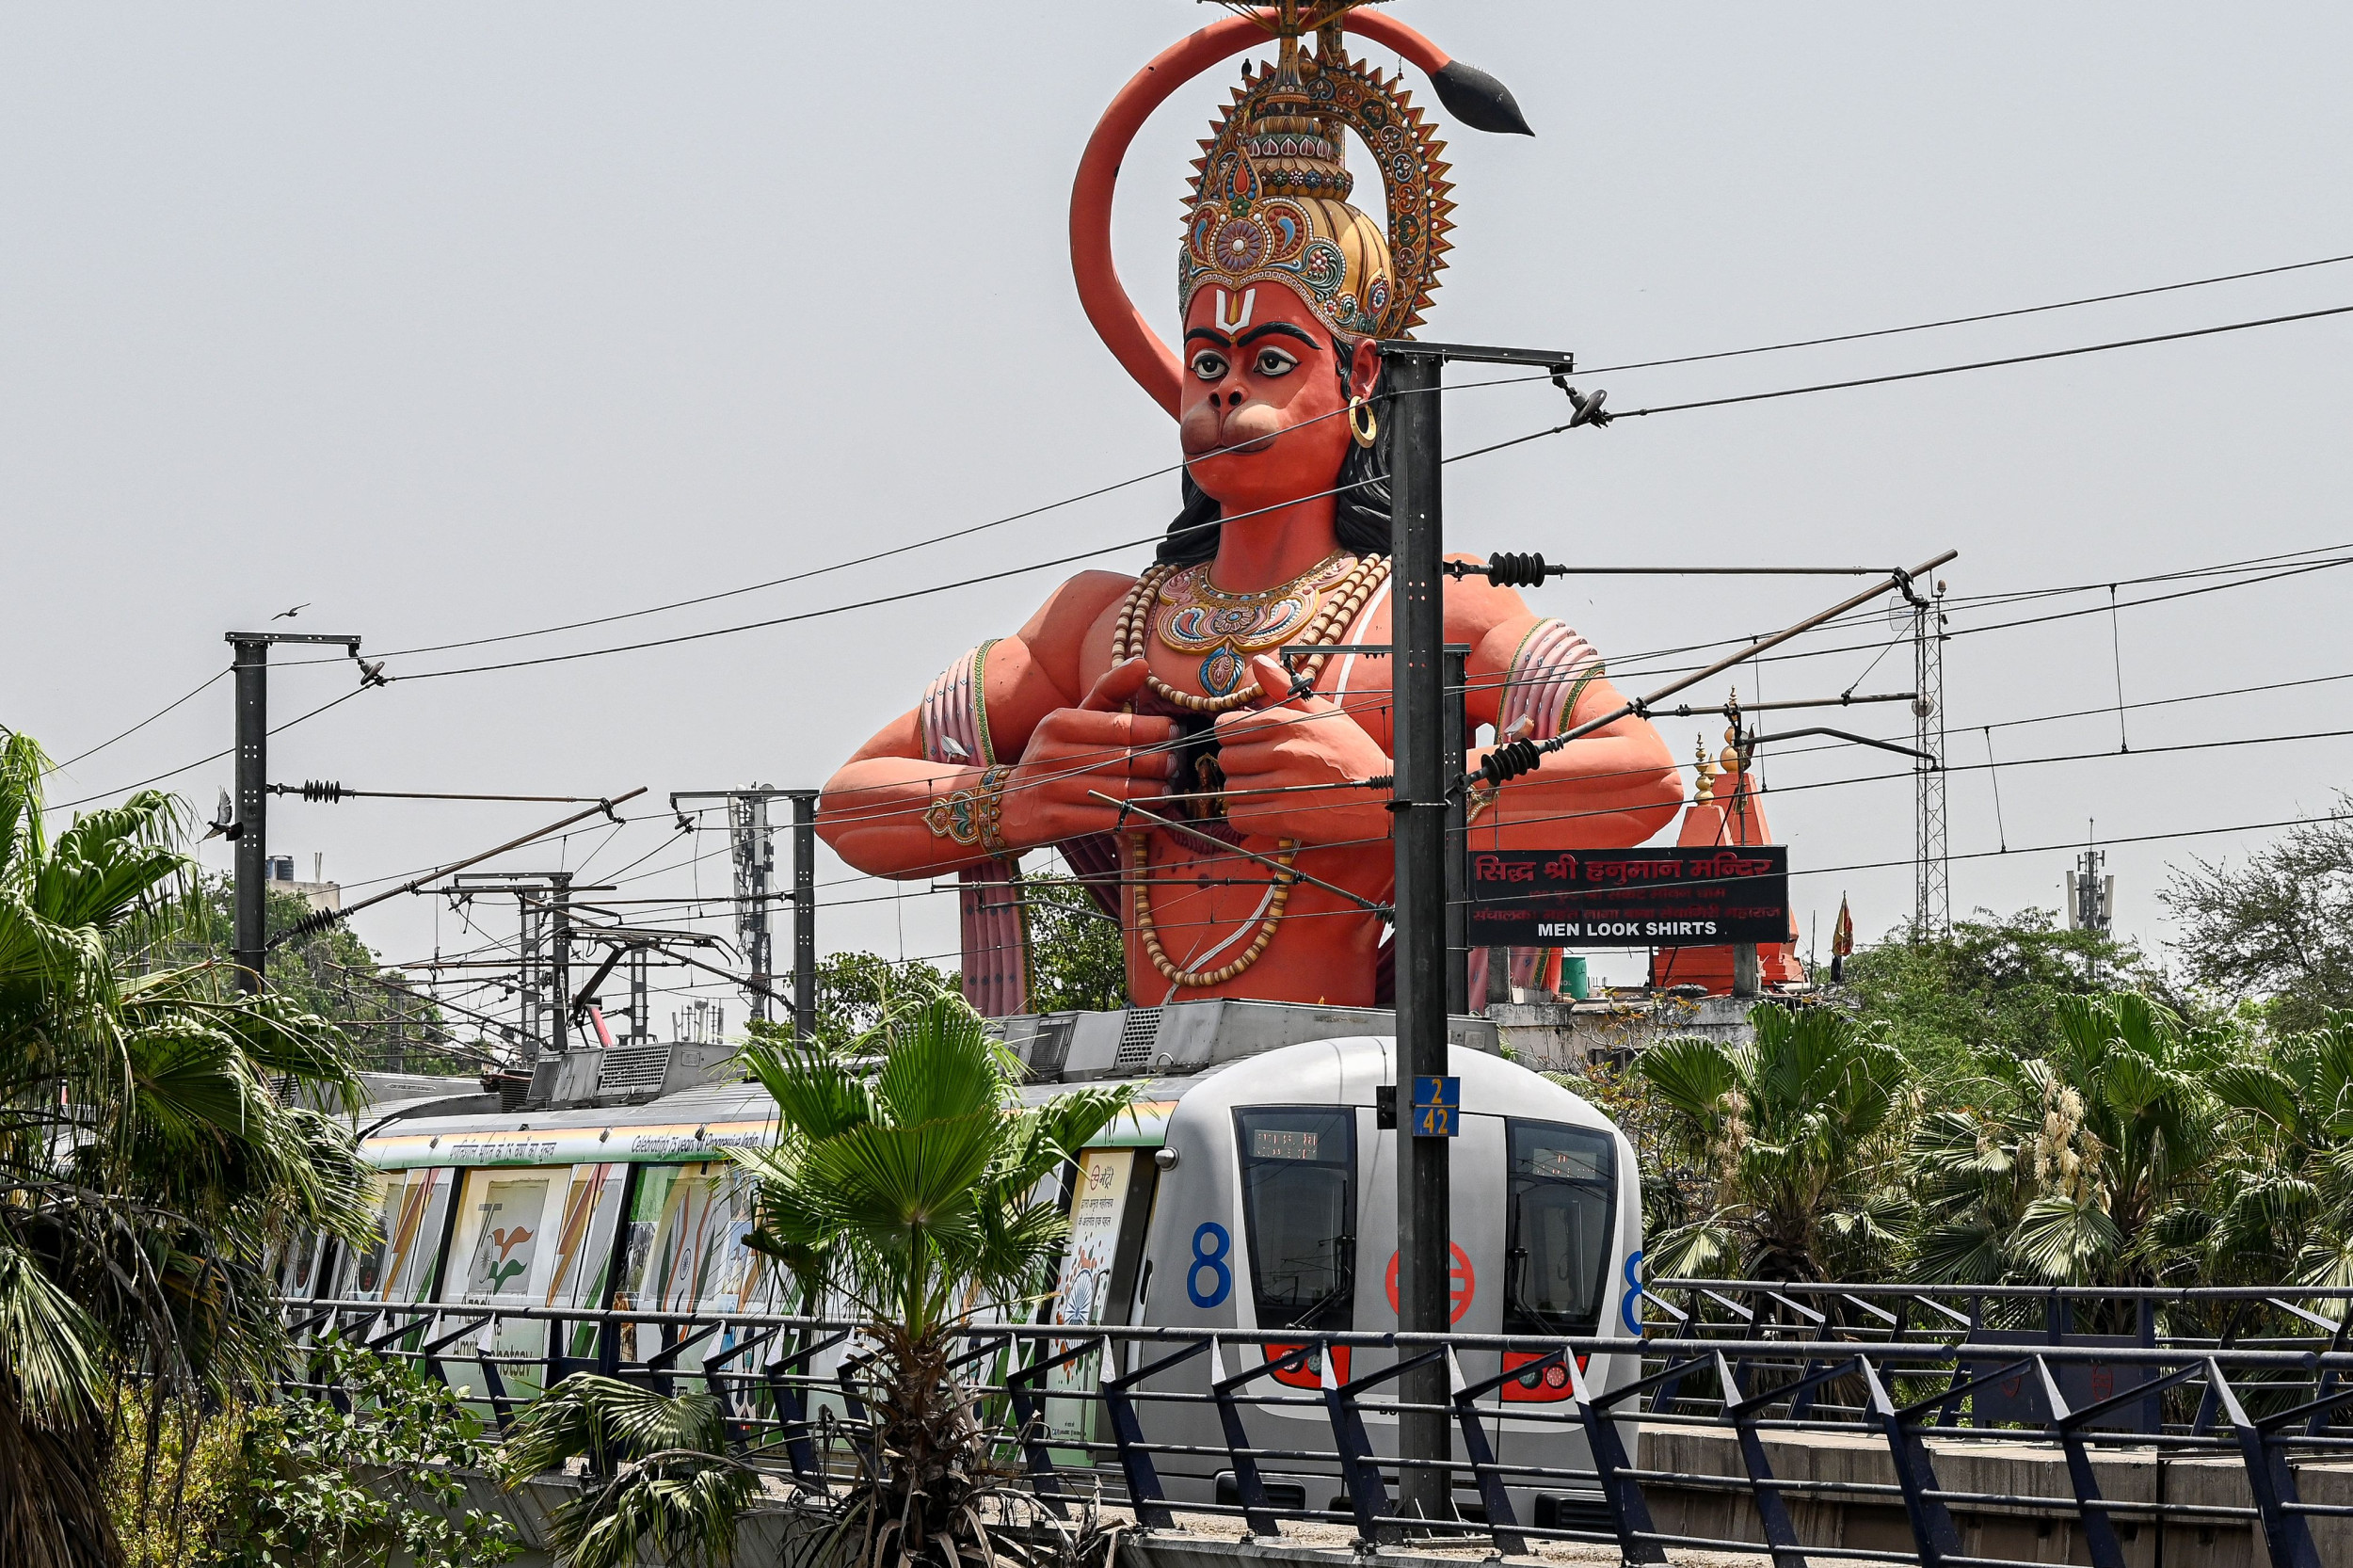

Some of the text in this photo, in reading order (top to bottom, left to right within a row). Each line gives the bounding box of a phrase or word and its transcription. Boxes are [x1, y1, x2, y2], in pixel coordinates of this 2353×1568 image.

[1475, 852, 1772, 886] सिद्ध श्री हनुमान मन्दिर
[1538, 921, 1717, 936] MEN LOOK SHIRTS
[1432, 1078, 1443, 1104] 2
[1422, 1108, 1449, 1134] 42
[632, 1134, 670, 1156] Celebrating
[668, 1136, 679, 1152] 75
[675, 1137, 696, 1156] years
[1187, 1222, 1232, 1308] 8
